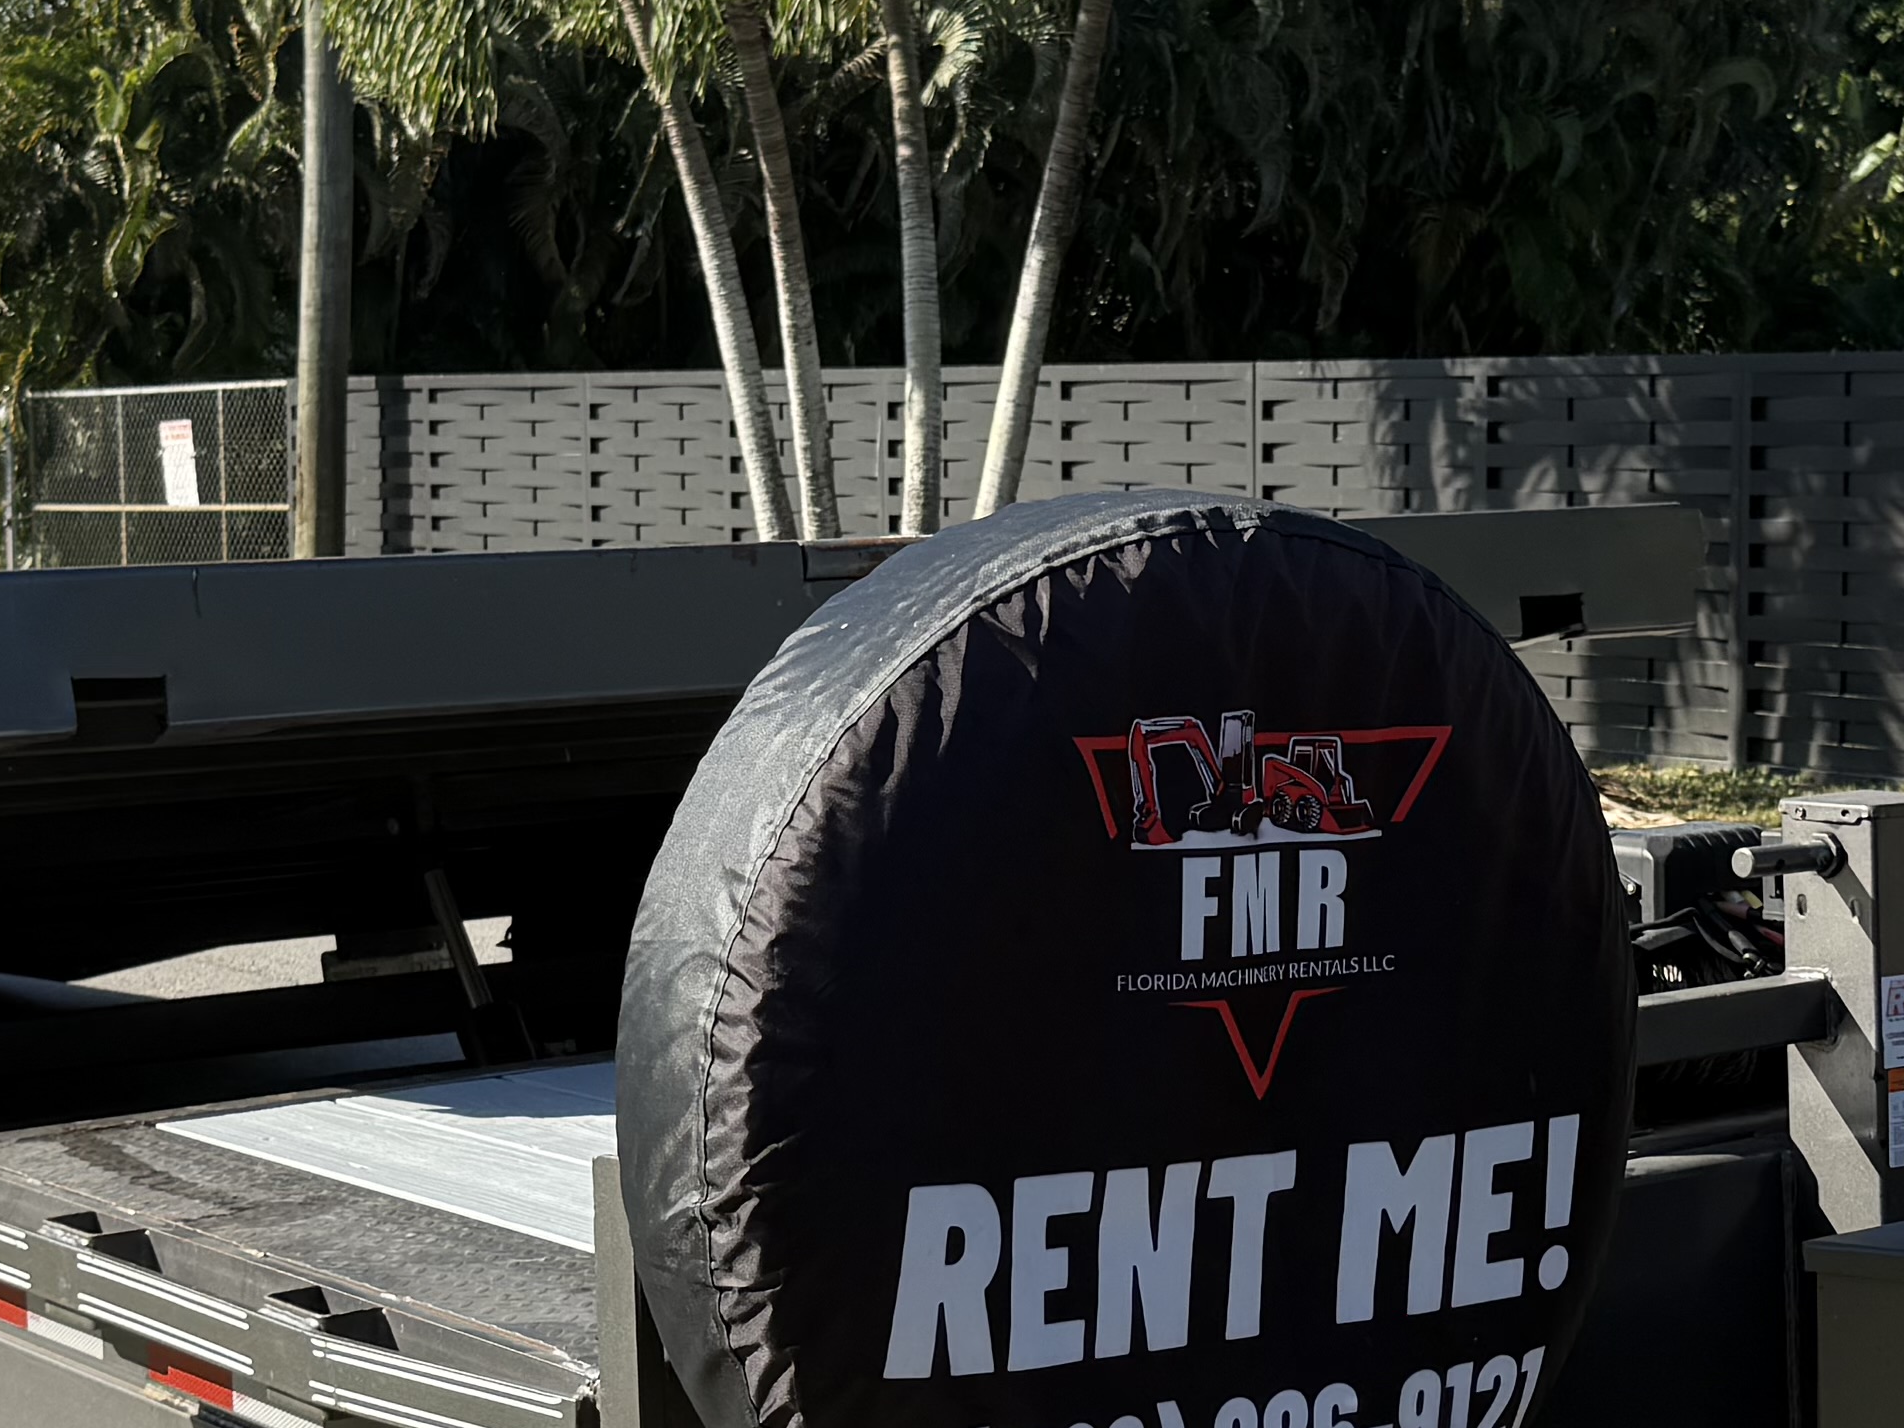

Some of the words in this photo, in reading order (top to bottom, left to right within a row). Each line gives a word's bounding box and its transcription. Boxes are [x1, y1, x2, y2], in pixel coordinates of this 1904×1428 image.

[1181, 848, 1348, 961] FMR
[1117, 972, 1197, 992] FLORIDA
[1201, 963, 1286, 990] MACHINERY
[1289, 956, 1360, 979] RENTALS
[1363, 954, 1396, 973] LLC
[882, 1150, 1297, 1379] RENT
[1336, 1113, 1580, 1325] ME!
